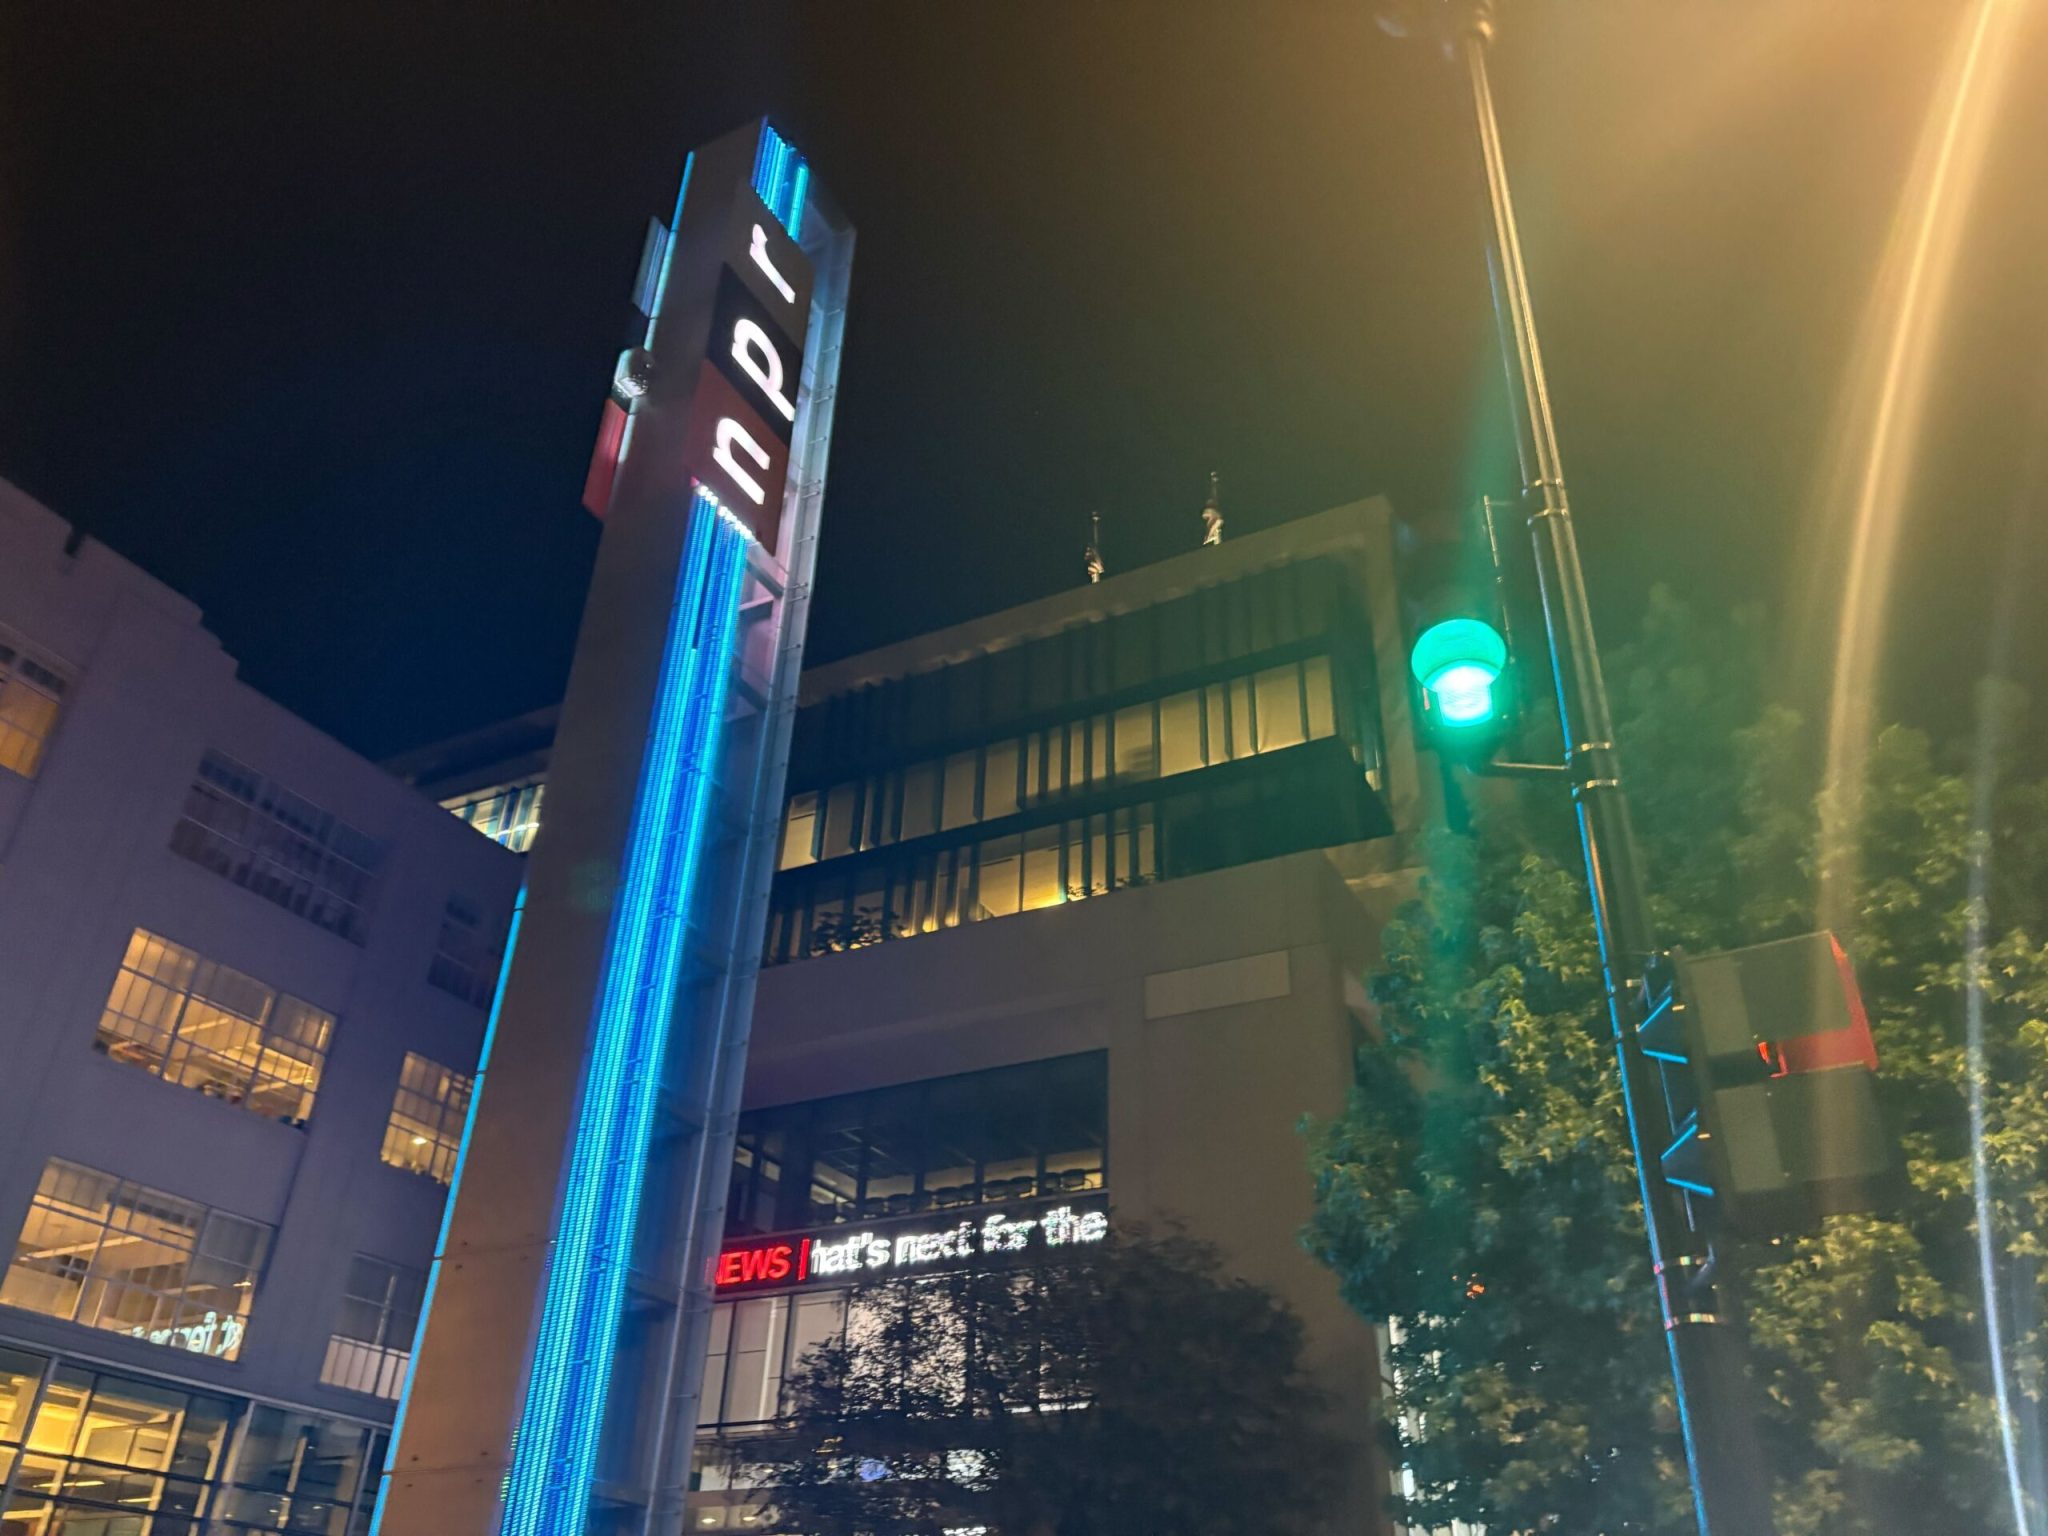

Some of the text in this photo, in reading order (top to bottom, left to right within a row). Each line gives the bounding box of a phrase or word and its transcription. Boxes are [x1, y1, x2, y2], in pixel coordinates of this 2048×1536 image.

[713, 223, 796, 505] npr
[981, 1214, 1037, 1252] for
[1040, 1206, 1109, 1246] the
